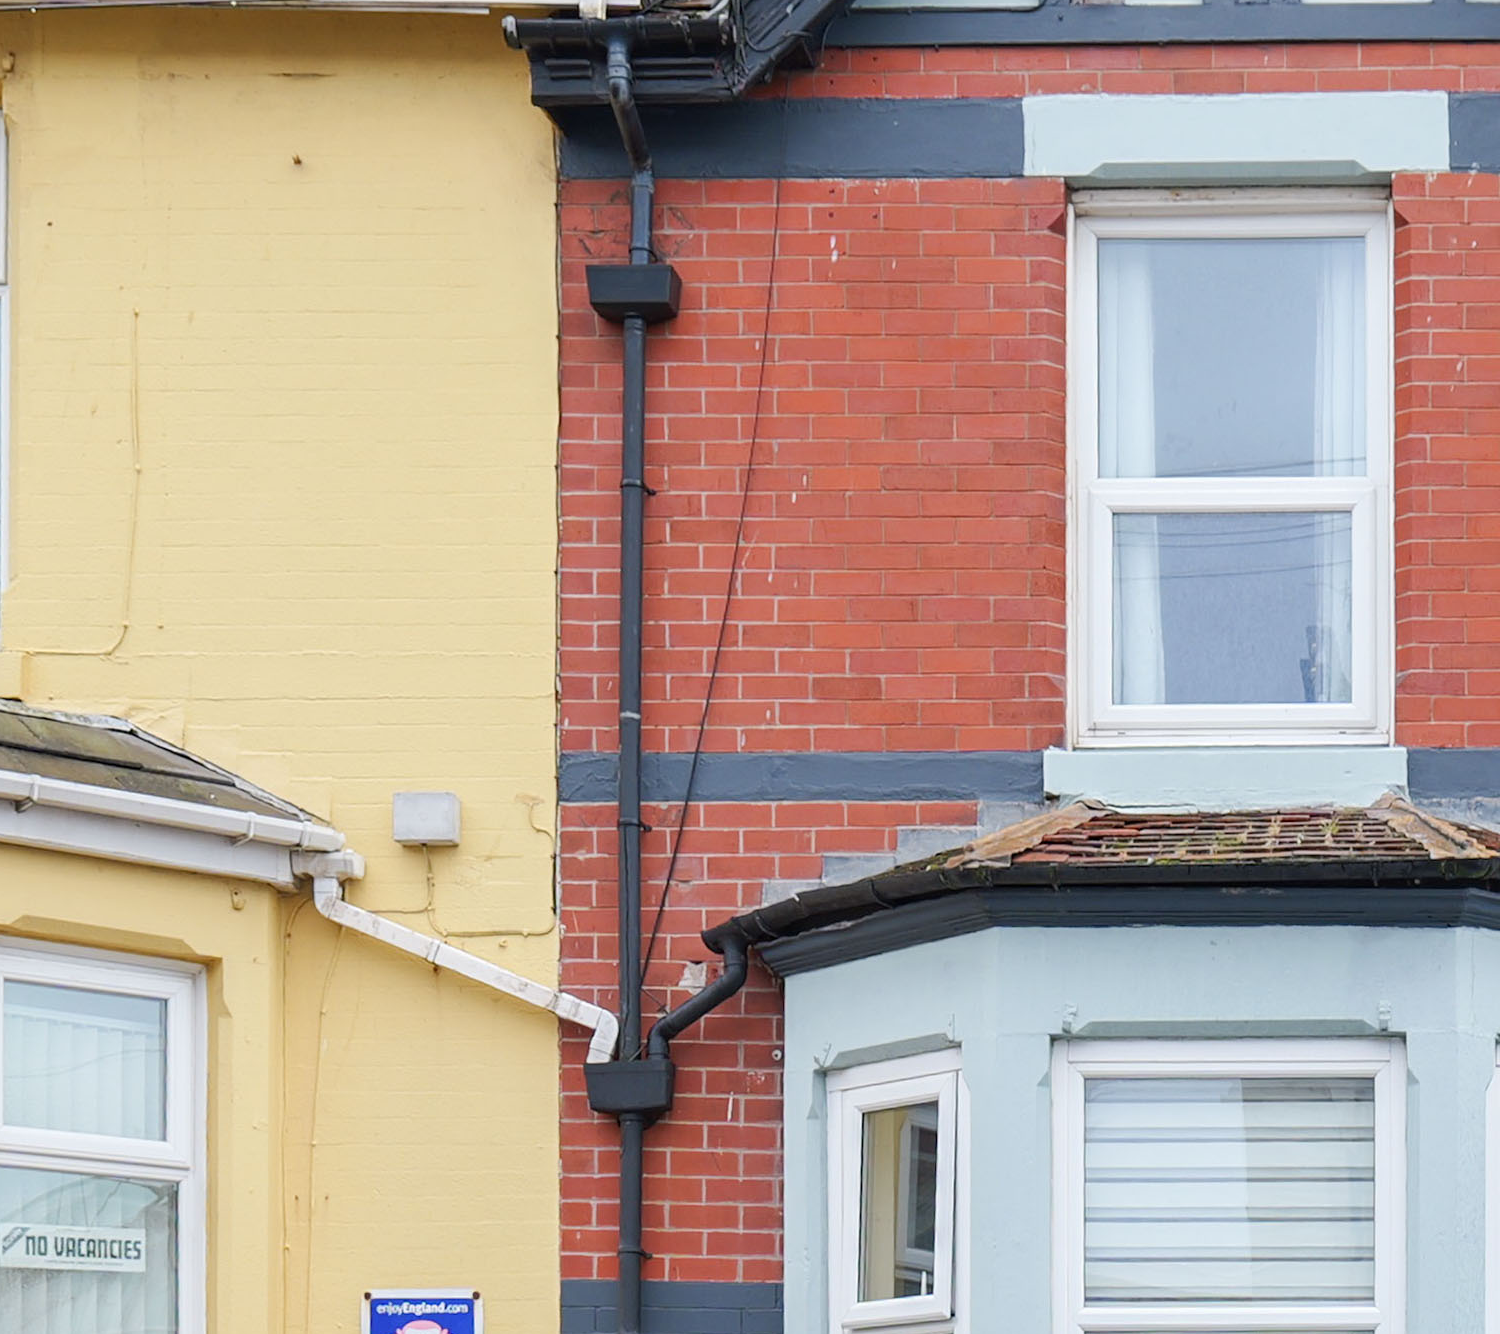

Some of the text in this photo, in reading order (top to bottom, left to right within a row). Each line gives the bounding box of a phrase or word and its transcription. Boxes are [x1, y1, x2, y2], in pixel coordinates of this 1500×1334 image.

[25, 1235, 48, 1257] NO
[54, 1236, 142, 1260] VACANCIES
[376, 1301, 469, 1316] enjoyEngland.com
